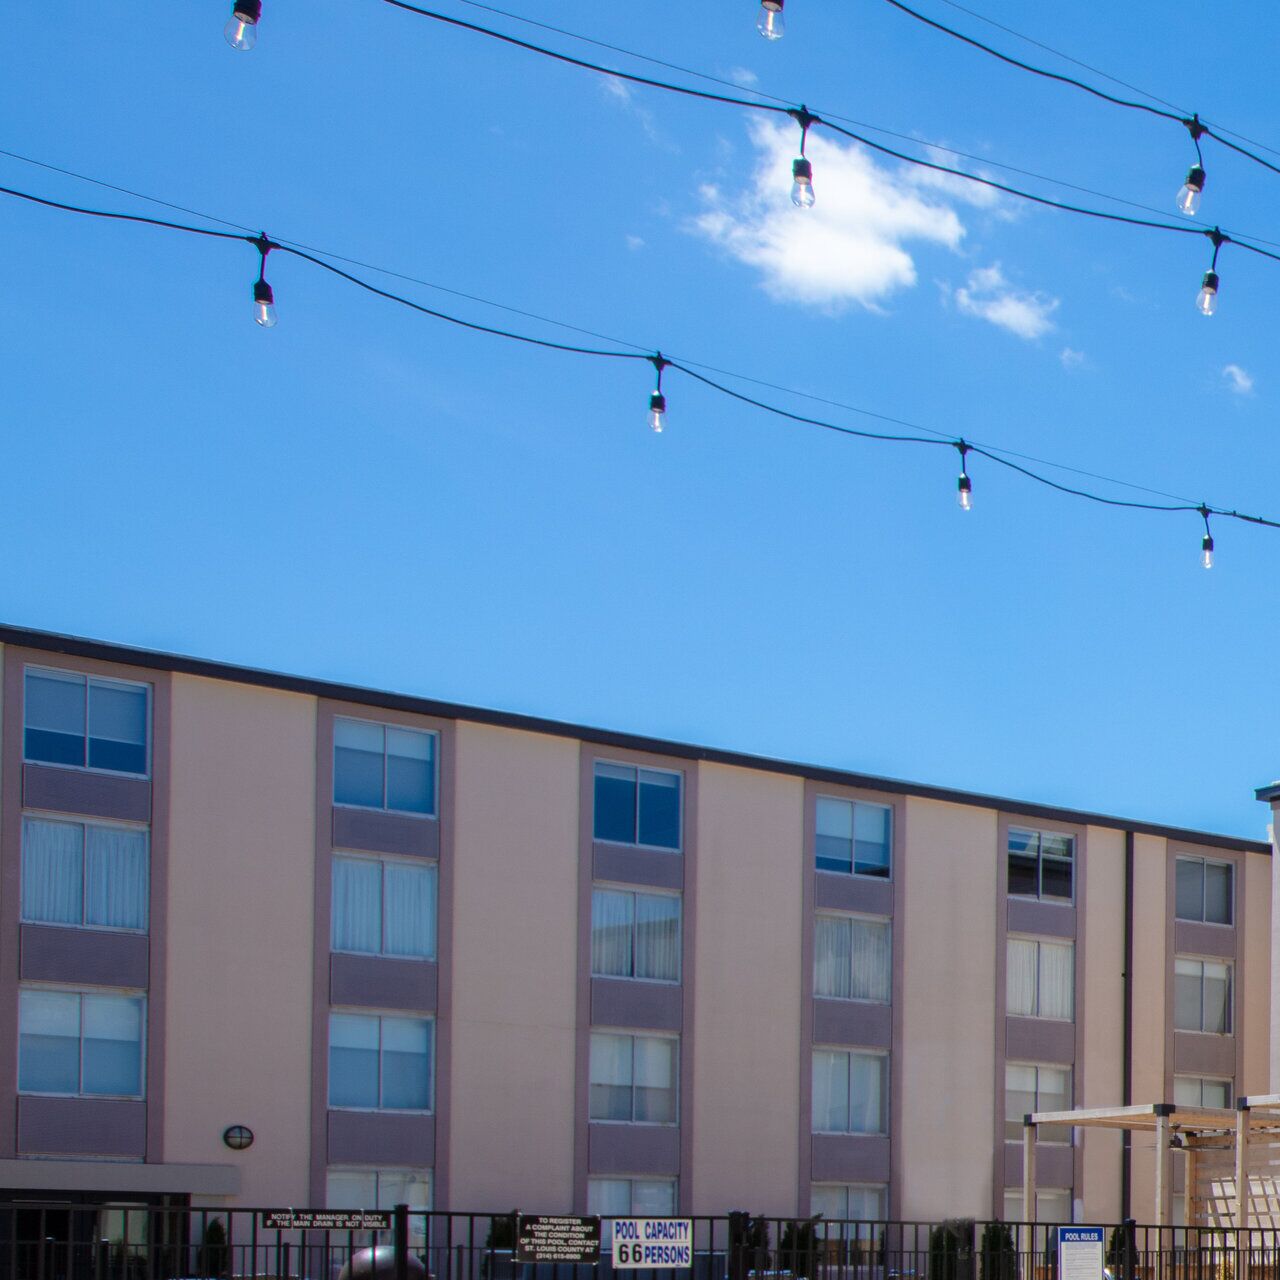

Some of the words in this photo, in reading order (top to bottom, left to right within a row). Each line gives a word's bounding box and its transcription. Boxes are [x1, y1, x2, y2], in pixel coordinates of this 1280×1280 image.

[615, 1221, 640, 1240] POOL
[644, 1221, 689, 1240] CAPACITY
[1064, 1232, 1080, 1241] POOL
[1080, 1232, 1099, 1241] RULES
[618, 1243, 643, 1263] 66
[644, 1245, 690, 1264] PERSONS
